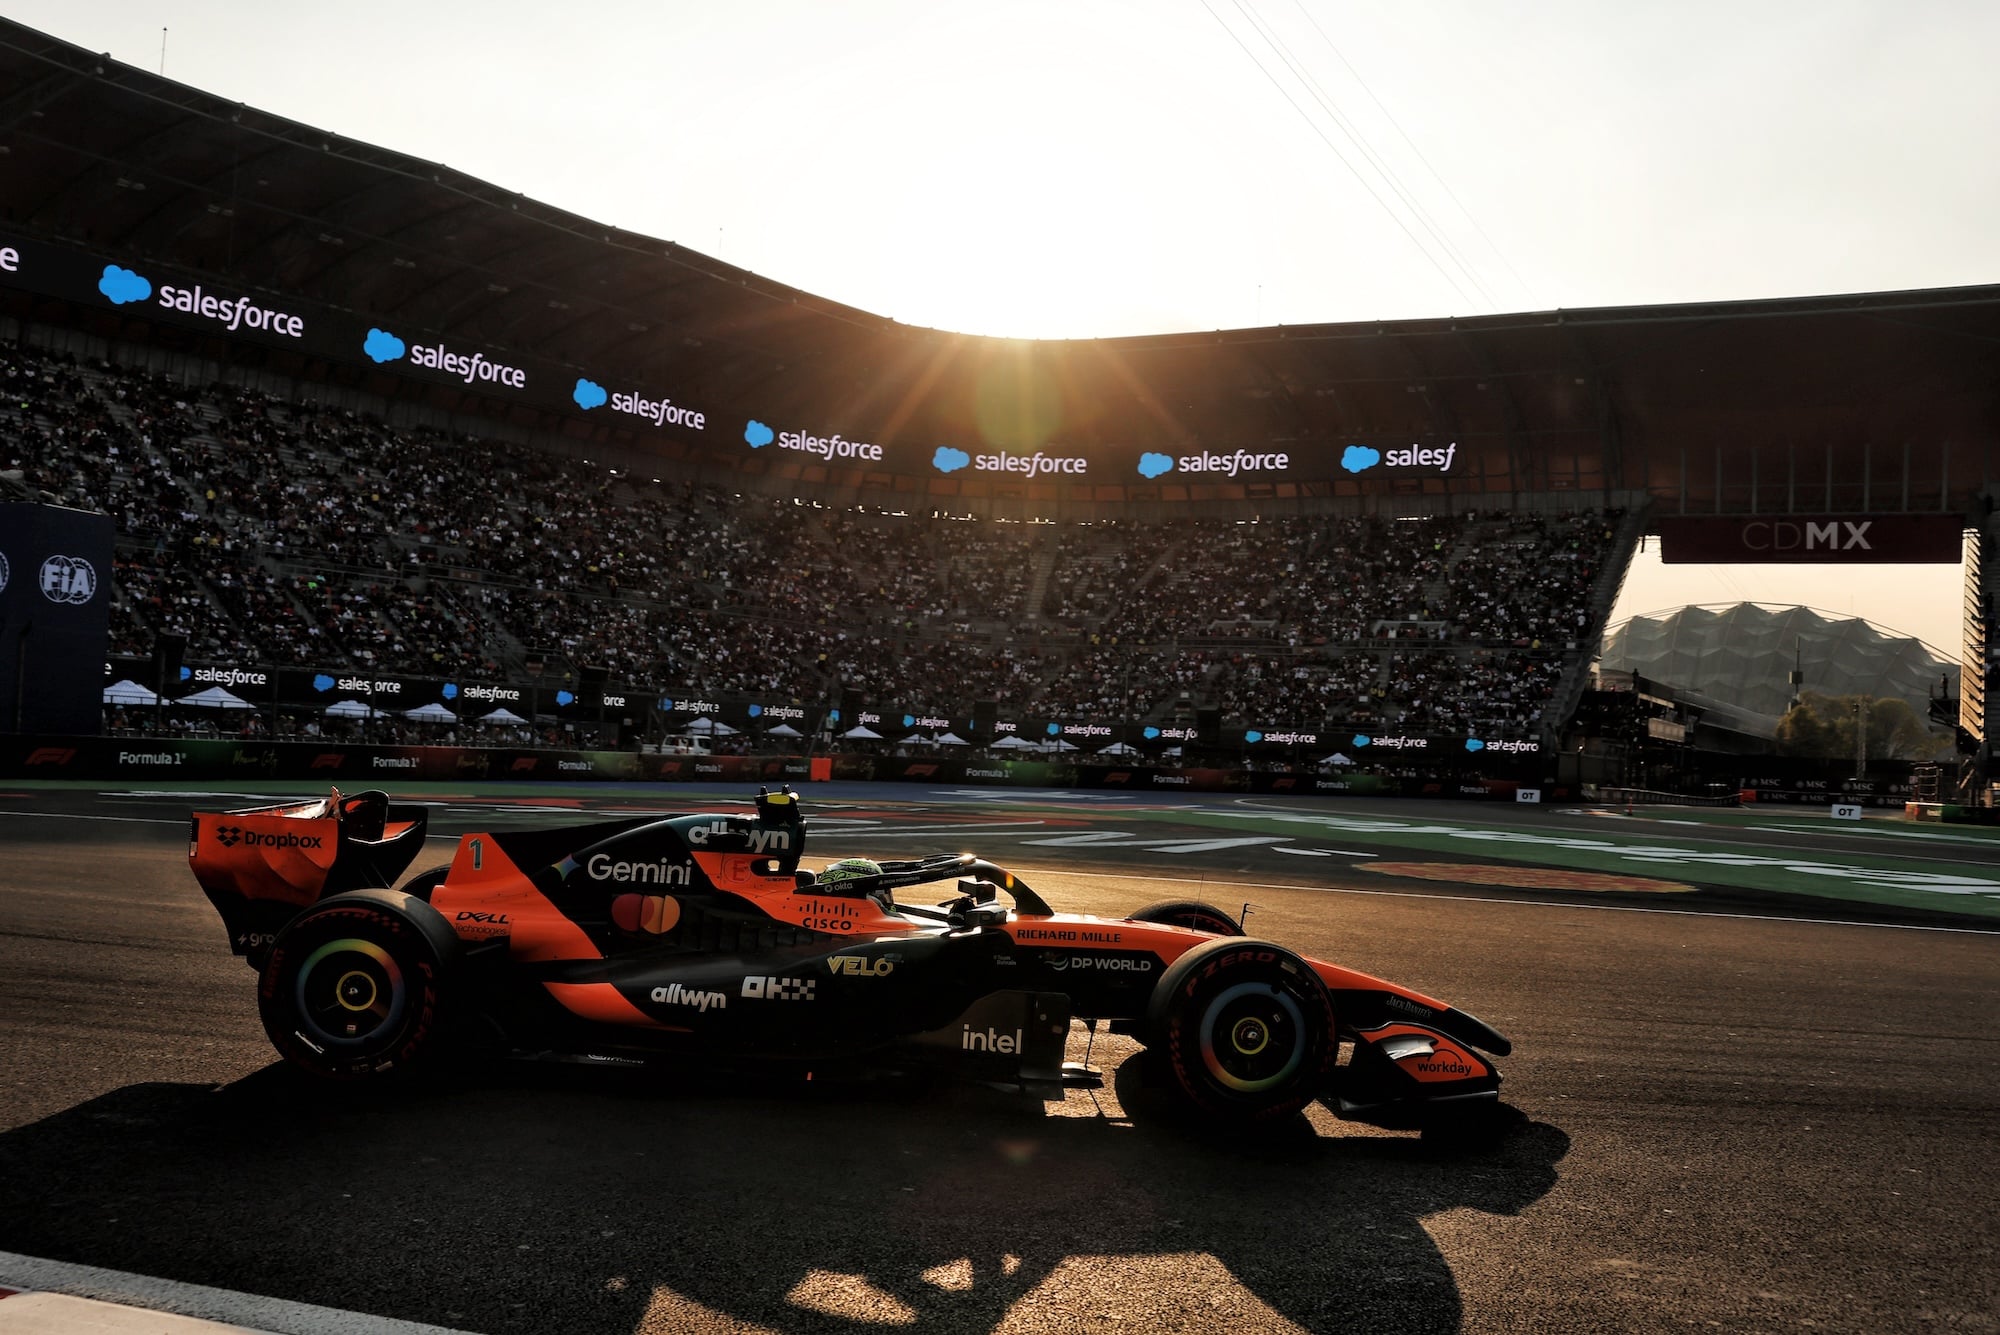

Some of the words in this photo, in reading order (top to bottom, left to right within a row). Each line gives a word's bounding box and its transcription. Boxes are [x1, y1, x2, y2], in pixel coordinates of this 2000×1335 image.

[158, 284, 304, 338] salesforce
[410, 343, 526, 388] salesforce
[611, 391, 706, 430] salesforce
[777, 429, 883, 461] salesforce
[974, 450, 1087, 478] salesforce
[1178, 448, 1289, 477] salesforce
[1385, 442, 1457, 472] salesf
[1742, 520, 1873, 551] CDMX
[194, 666, 267, 688] salesforce
[463, 685, 520, 703] salesforce
[1063, 724, 1112, 738] salesforce
[119, 751, 172, 766] Formula
[1759, 777, 1782, 787] MSC
[1805, 780, 1828, 789] MSC
[1851, 782, 1875, 791] MSC
[1522, 792, 1535, 800] OT
[1838, 808, 1855, 817] OT
[245, 831, 322, 849] Dropbox
[468, 838, 482, 871] 1
[587, 853, 693, 886] Gemini
[456, 911, 509, 924] DELL
[803, 917, 852, 930] CISCO
[1016, 928, 1077, 941] RICHARD
[1081, 932, 1121, 943] MILLE
[826, 955, 894, 977] VELO
[1071, 956, 1092, 970] DP
[1094, 957, 1152, 972] WORLD
[650, 982, 728, 1013] allwyn
[962, 1023, 1023, 1055] intel
[1418, 1060, 1472, 1076] workday
